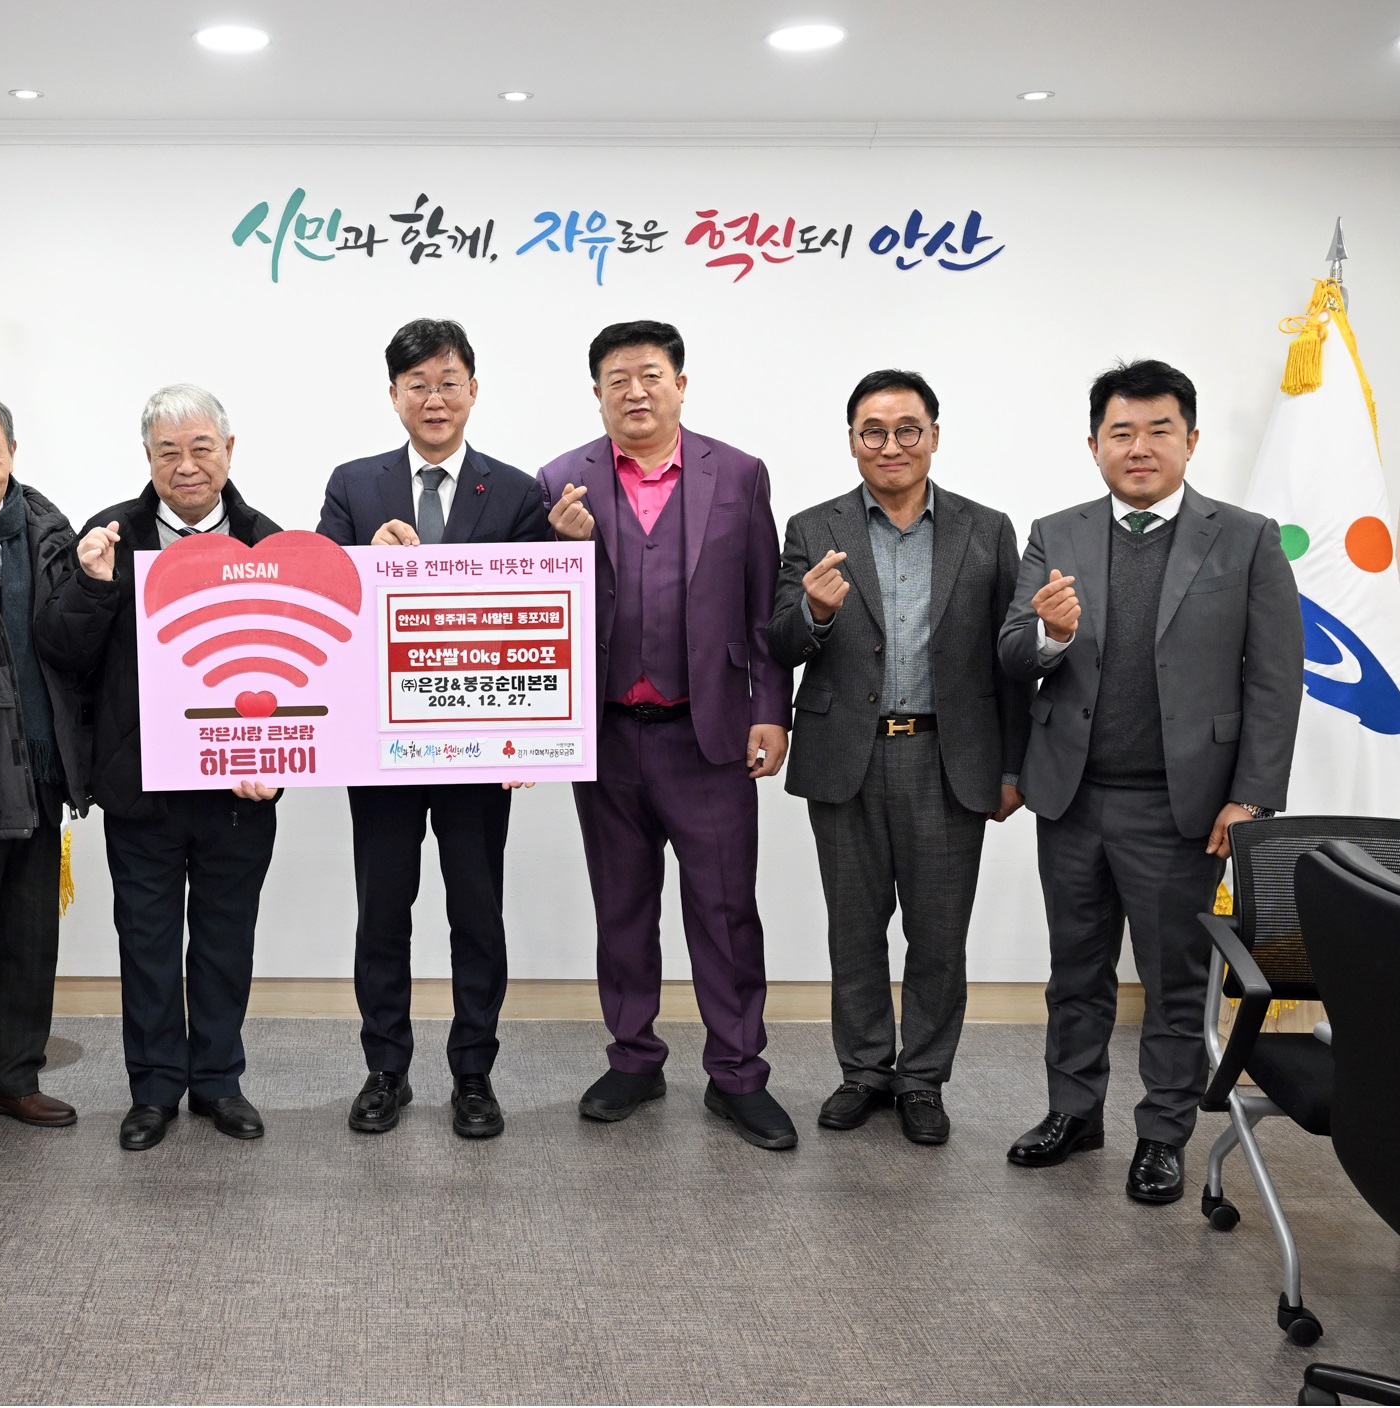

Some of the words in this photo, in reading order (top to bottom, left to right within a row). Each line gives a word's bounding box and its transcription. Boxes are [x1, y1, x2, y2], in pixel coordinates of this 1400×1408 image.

[232, 187, 389, 283] 시민과
[389, 193, 497, 264] 함께,
[516, 210, 668, 286] 자유로운
[685, 209, 852, 283] 혁신도시
[869, 209, 1005, 271] 안산
[222, 563, 278, 581] ANSAN
[377, 561, 418, 577] 나눔을
[425, 560, 483, 576] 전파하는
[490, 558, 534, 575] 따뜻한
[540, 557, 582, 573] 에너지
[398, 614, 430, 626] 안산시
[434, 613, 477, 625] 영주귀국
[481, 613, 513, 624] 사할린
[518, 612, 559, 624] 동포지원
[408, 648, 500, 666] 안산쌀10kg
[507, 647, 556, 664] 500포
[429, 695, 470, 707] 2024.
[479, 695, 500, 707] 12.
[508, 694, 531, 706] 27.
[199, 726, 262, 742] 작은사랑
[267, 725, 315, 740] 큰보람
[200, 746, 316, 776] 하트파이
